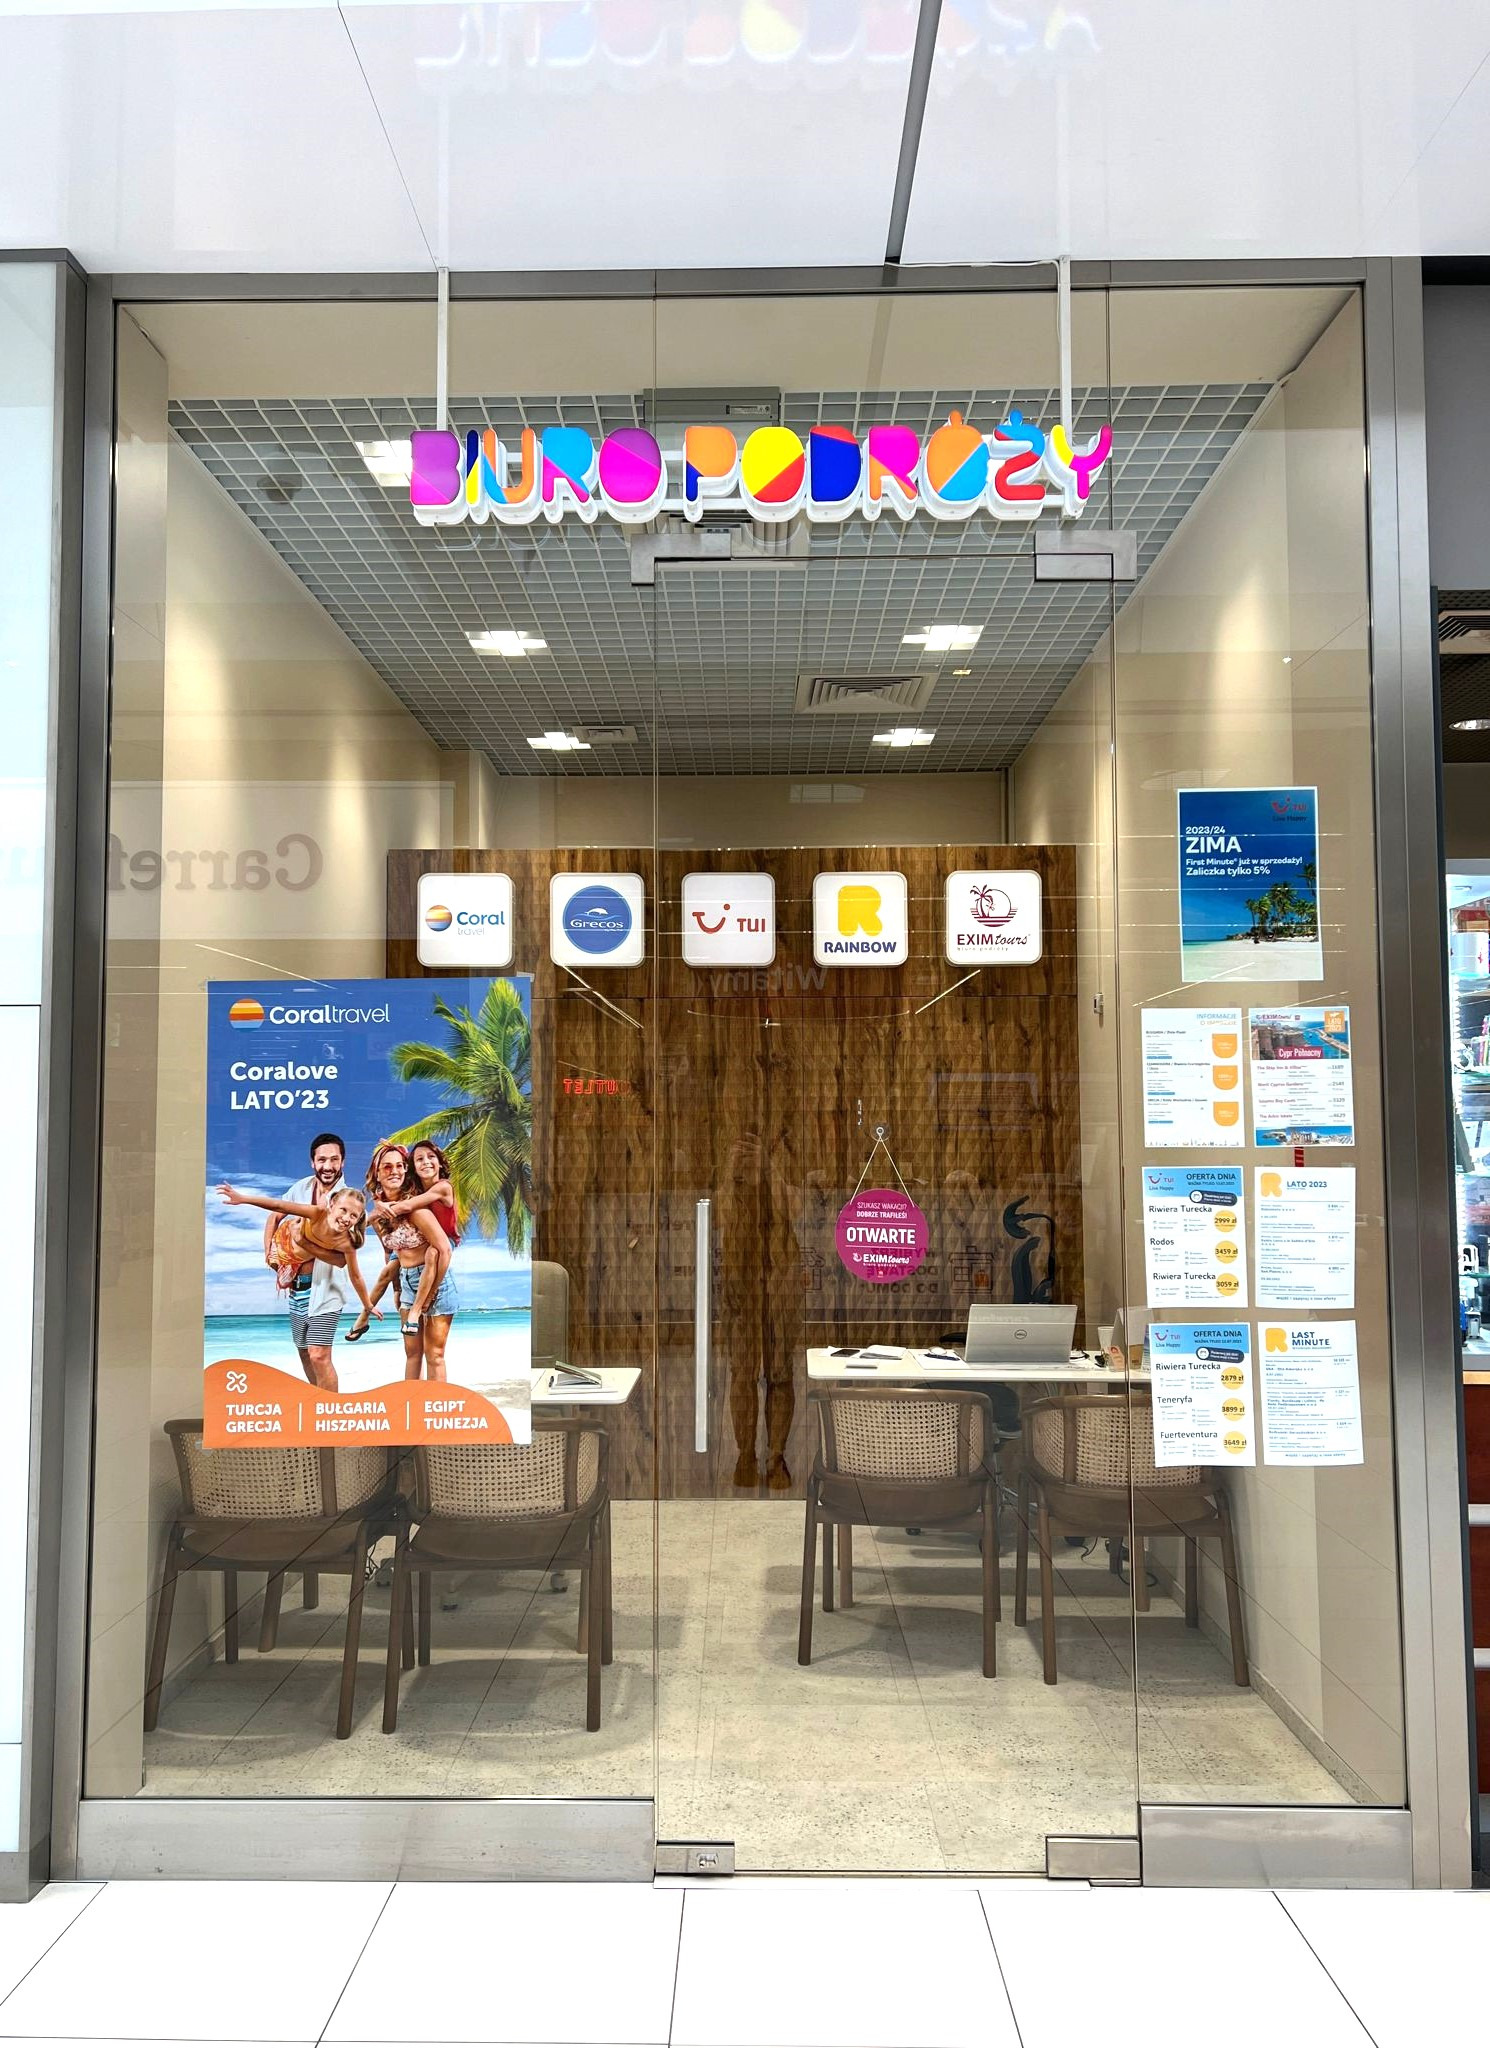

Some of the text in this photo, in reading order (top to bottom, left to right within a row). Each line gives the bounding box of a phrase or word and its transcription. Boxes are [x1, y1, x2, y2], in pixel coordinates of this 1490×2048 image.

[411, 410, 1112, 518] BIURO PODRÓŻY
[1185, 826, 1226, 834] 2023/24
[1185, 836, 1242, 854] ZIMA
[1186, 858, 1205, 866] First
[1238, 857, 1251, 867] już
[1260, 857, 1303, 866] sprzedaży!
[1186, 866, 1271, 877] Zaliczka tylko 5%
[457, 910, 505, 926] Coral
[569, 918, 624, 930] Grecos
[457, 927, 485, 936] travel
[736, 918, 766, 933] TUI
[823, 941, 897, 954] RAINBOW
[269, 1003, 390, 1025] Coraltravel
[1278, 1047, 1322, 1058] Cypr Północny
[230, 1061, 338, 1081] Coralove
[230, 1089, 330, 1110] LATO'23
[1186, 1173, 1216, 1181] OFERTA
[856, 1210, 879, 1218] DOBRZE
[1148, 1204, 1213, 1213] Riwiera Turecka
[846, 1226, 916, 1244] OTWARTE
[1150, 1238, 1175, 1246] Rodos
[863, 1253, 910, 1264] EXIMtours
[1153, 1272, 1216, 1280] Riwiera Turecka
[1188, 1362, 1221, 1370] Turecka
[1238, 1374, 1244, 1382] zł
[1157, 1395, 1193, 1404] Teneryfa
[226, 1403, 282, 1416] TURCJA
[315, 1402, 387, 1415] BUŁGARIA
[424, 1400, 466, 1413] EGIPT
[226, 1420, 282, 1433] GRECJA
[315, 1419, 391, 1432] HISZPANIA
[423, 1417, 488, 1430] TUNEZJA
[1160, 1431, 1218, 1439] Fuerteventura
